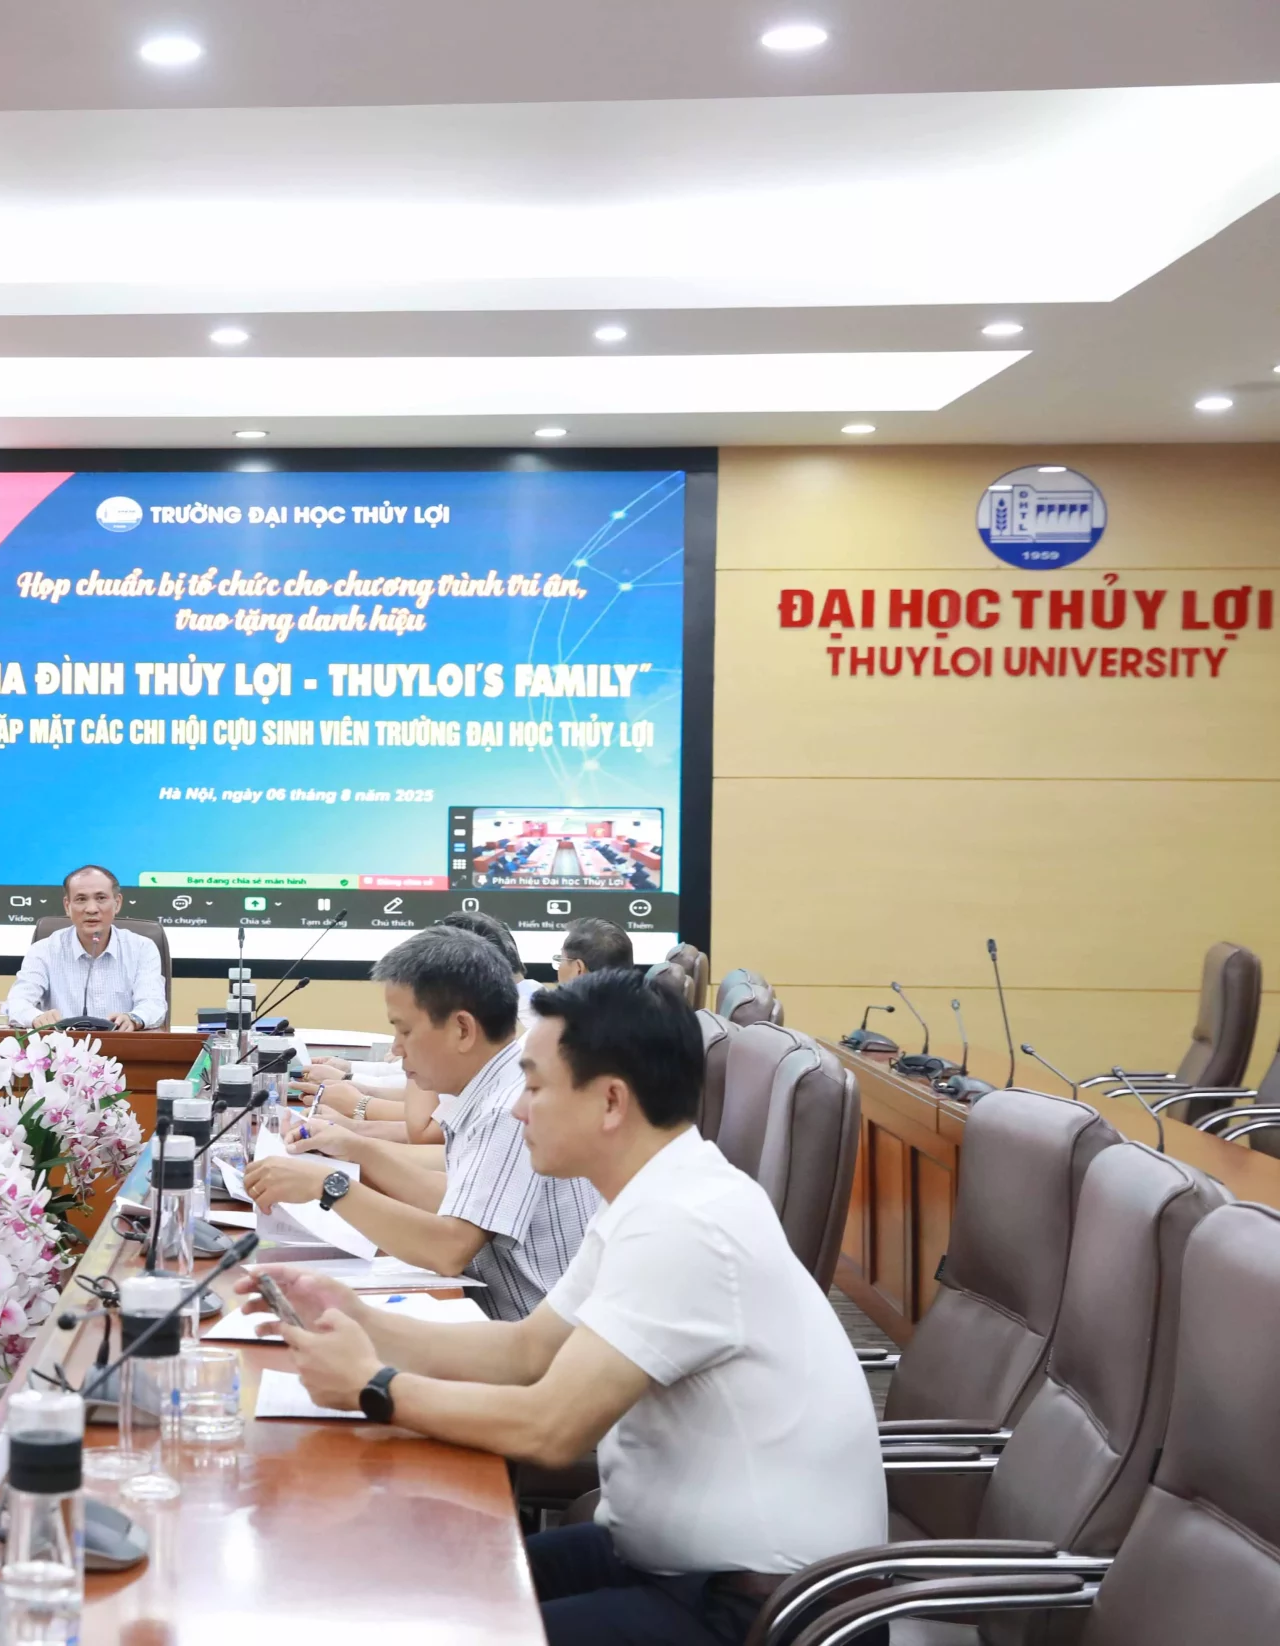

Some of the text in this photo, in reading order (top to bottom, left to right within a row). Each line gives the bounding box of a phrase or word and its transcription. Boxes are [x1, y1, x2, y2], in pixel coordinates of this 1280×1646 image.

[150, 501, 450, 528] TRƯỜNG ĐẠI HỌC THỦY LỢI
[1022, 551, 1060, 560] 1959
[17, 567, 587, 609] Họp chuẩn bị tổ chức cho chương trình tri ân,
[778, 573, 1273, 640] ĐẠI HỌC THỦY LỢI
[175, 604, 427, 643] trao tặng danh hiệu
[827, 646, 1228, 679] THUYLOI UNIVERSITY
[34, 654, 124, 695] ĐÌNH
[135, 653, 226, 696] THỦY
[235, 661, 292, 705] LỢI
[304, 678, 317, 690] -
[29, 713, 75, 750] MẶT
[81, 714, 123, 745] CÁC
[129, 719, 165, 745] CHI
[172, 714, 207, 751] HỘI
[213, 717, 256, 751] CỰU
[262, 719, 314, 746] SINH
[320, 715, 369, 746] VIÊN
[375, 715, 460, 747] TRƯỜNG
[466, 721, 503, 752] ĐẠI
[509, 721, 553, 752] HỌC
[559, 713, 614, 747] THỦY
[620, 718, 654, 752] LỢI
[159, 787, 181, 800] Hà
[185, 787, 217, 803] Nội,
[222, 789, 262, 803] ngày
[266, 788, 286, 801] 06
[290, 788, 336, 804] tháng
[355, 789, 391, 802] năm
[394, 789, 434, 802] 2025
[187, 876, 204, 885] Bạn
[207, 877, 229, 886] đang
[232, 877, 250, 885] chia
[492, 876, 516, 886] Phân
[8, 914, 34, 922] Video
[175, 916, 207, 926] chuyện
[240, 917, 259, 925] Chia
